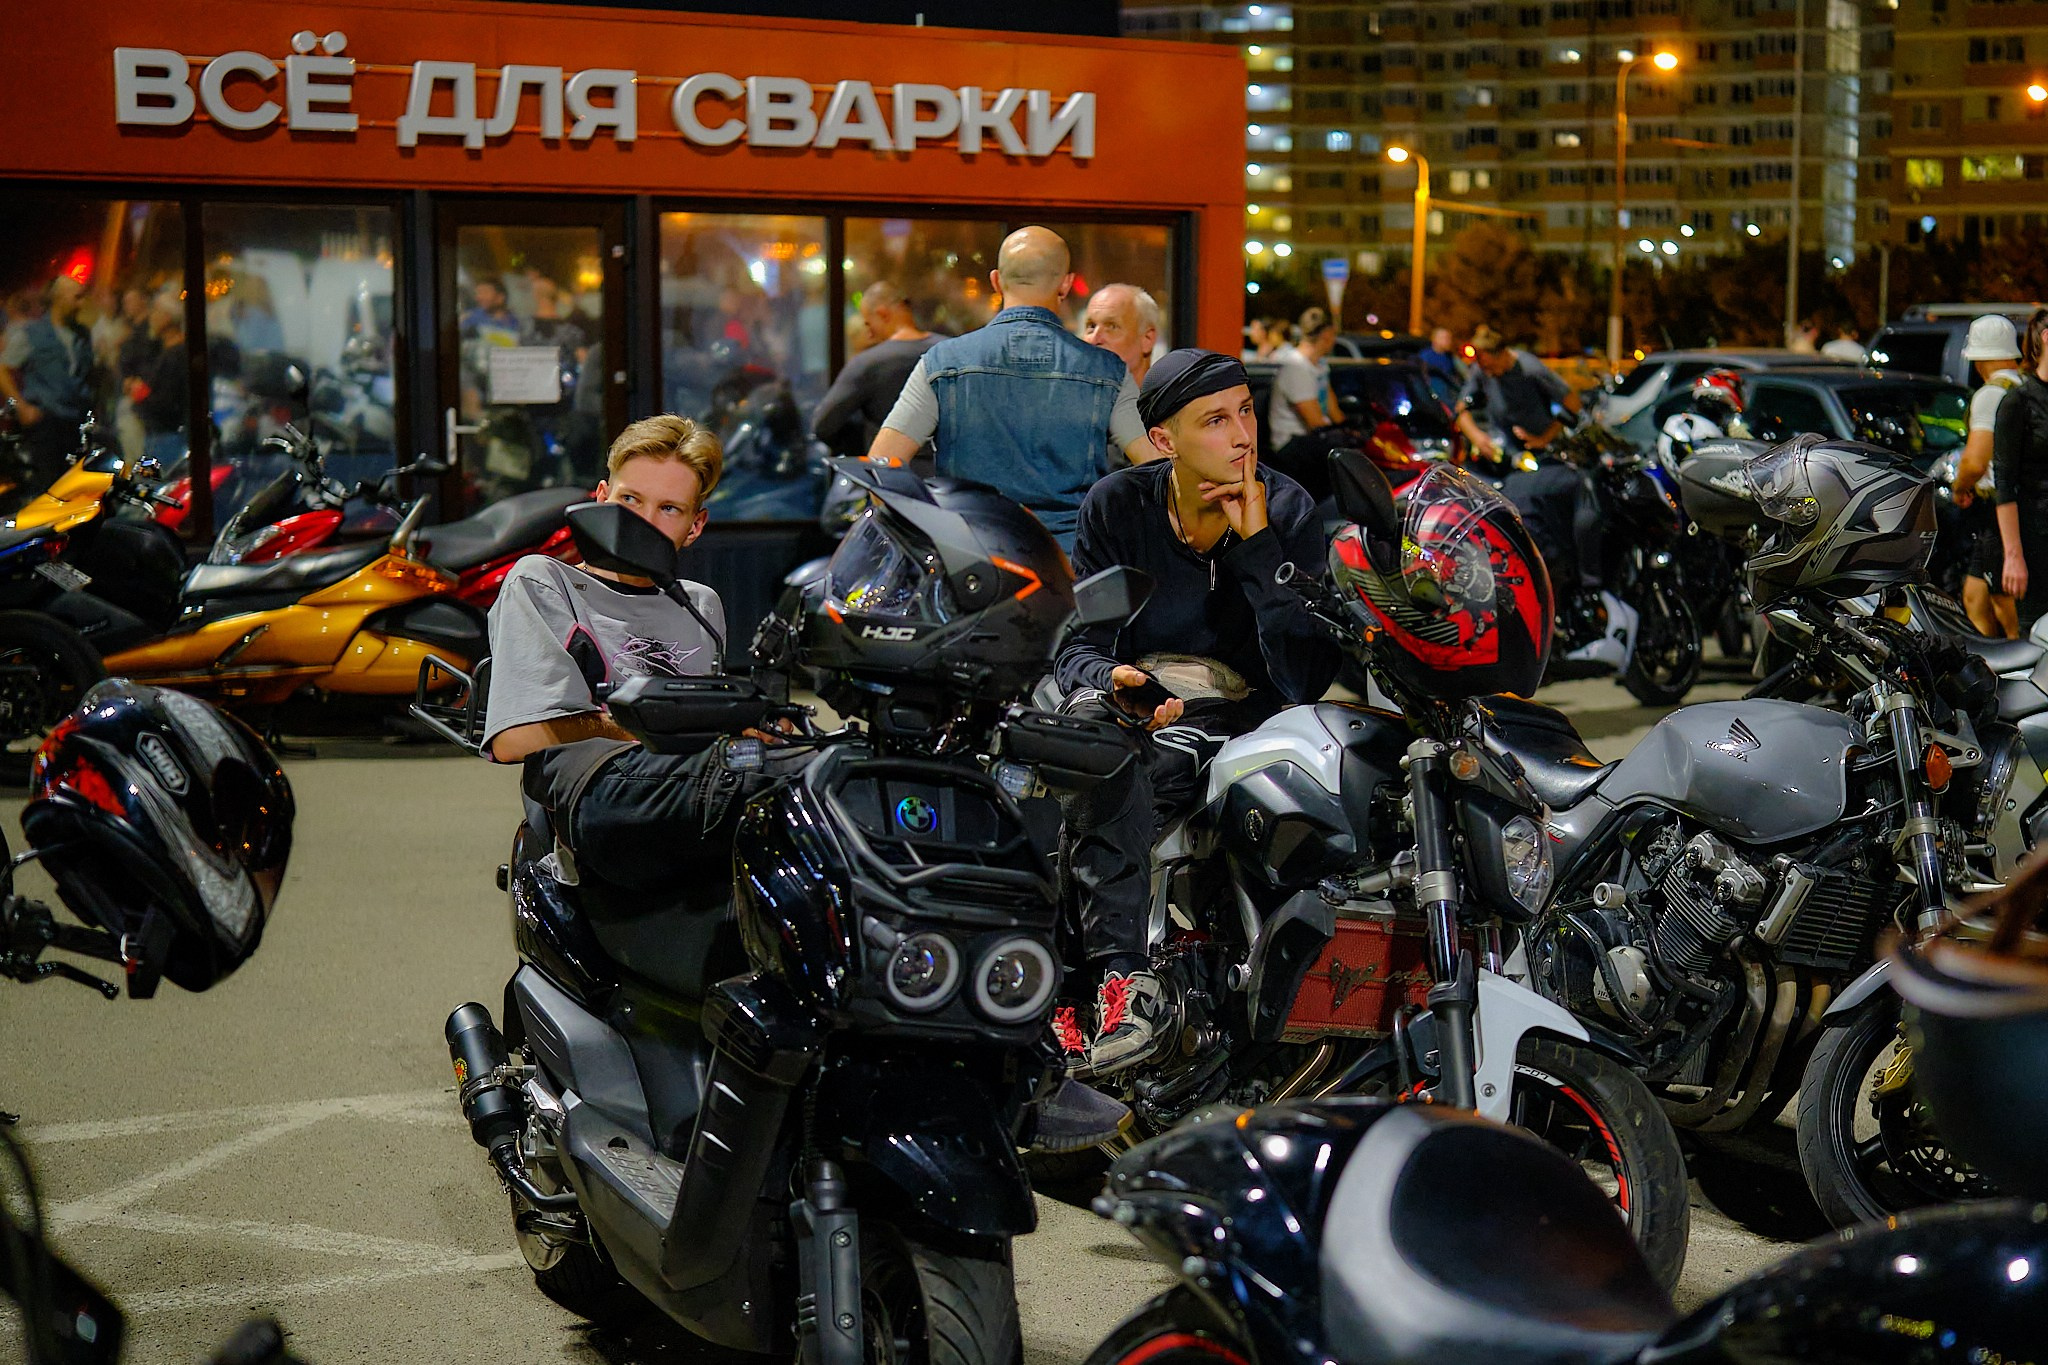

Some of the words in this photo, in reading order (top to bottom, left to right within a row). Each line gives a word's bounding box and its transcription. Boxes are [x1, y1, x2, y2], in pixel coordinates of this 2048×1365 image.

[113, 29, 360, 132] ВСЁ
[395, 60, 639, 150] ДЛЯ
[671, 71, 1097, 159] СВАРКИ
[861, 624, 917, 641] HJC
[141, 737, 186, 789] SHOEI
[1514, 1064, 1550, 1080] T-07
